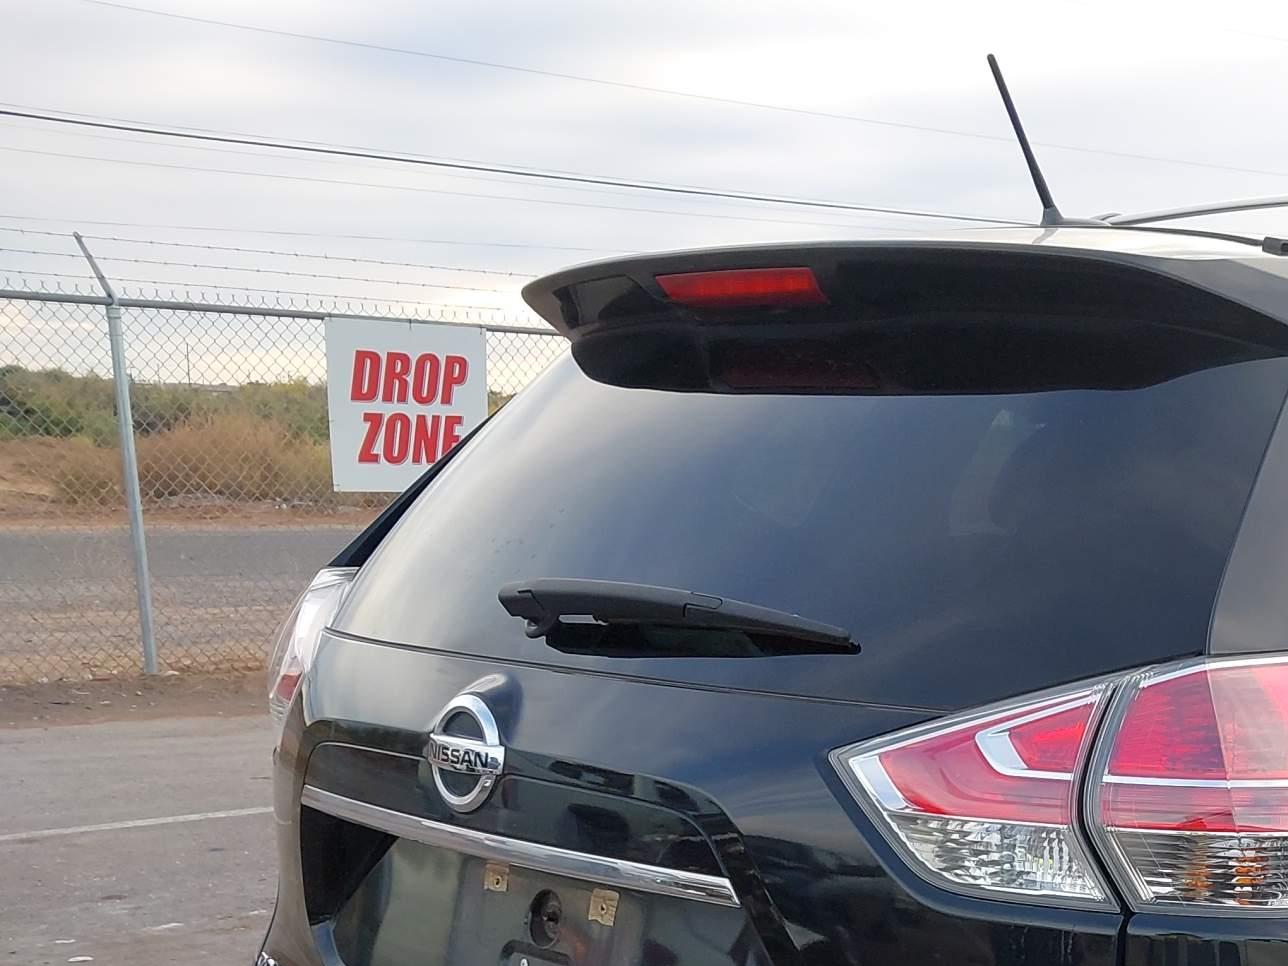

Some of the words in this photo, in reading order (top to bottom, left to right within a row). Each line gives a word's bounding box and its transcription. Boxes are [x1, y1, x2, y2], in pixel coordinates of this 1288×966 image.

[350, 349, 469, 405] DROP
[358, 412, 465, 465] ZONE
[429, 739, 489, 769] NISSAN
